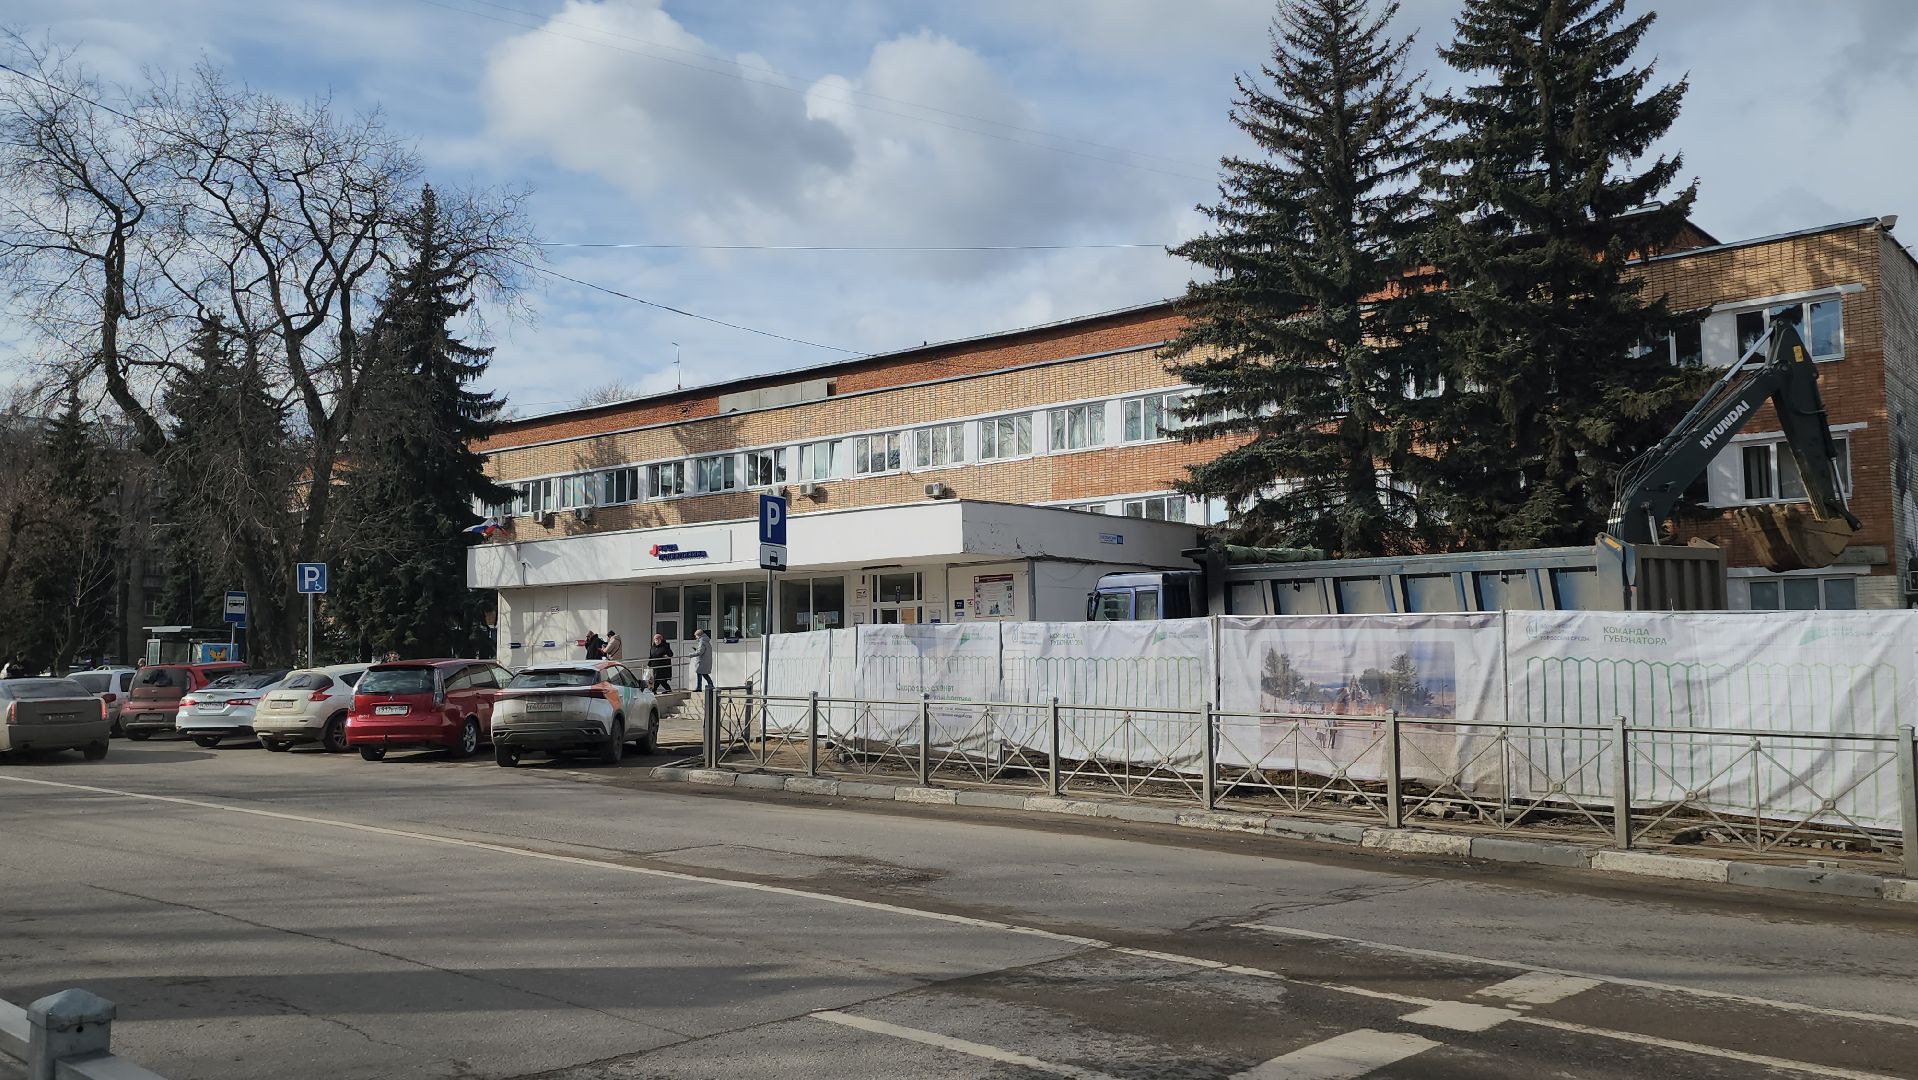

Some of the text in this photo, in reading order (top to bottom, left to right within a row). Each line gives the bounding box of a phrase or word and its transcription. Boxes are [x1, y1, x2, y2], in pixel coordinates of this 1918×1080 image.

[1699, 399, 1750, 449] HYUNDAI
[766, 500, 780, 539] P
[304, 566, 320, 590] P
[1603, 626, 1650, 636] КОМАНДА
[1603, 635, 1668, 646] ГУБЕРНАТОРА
